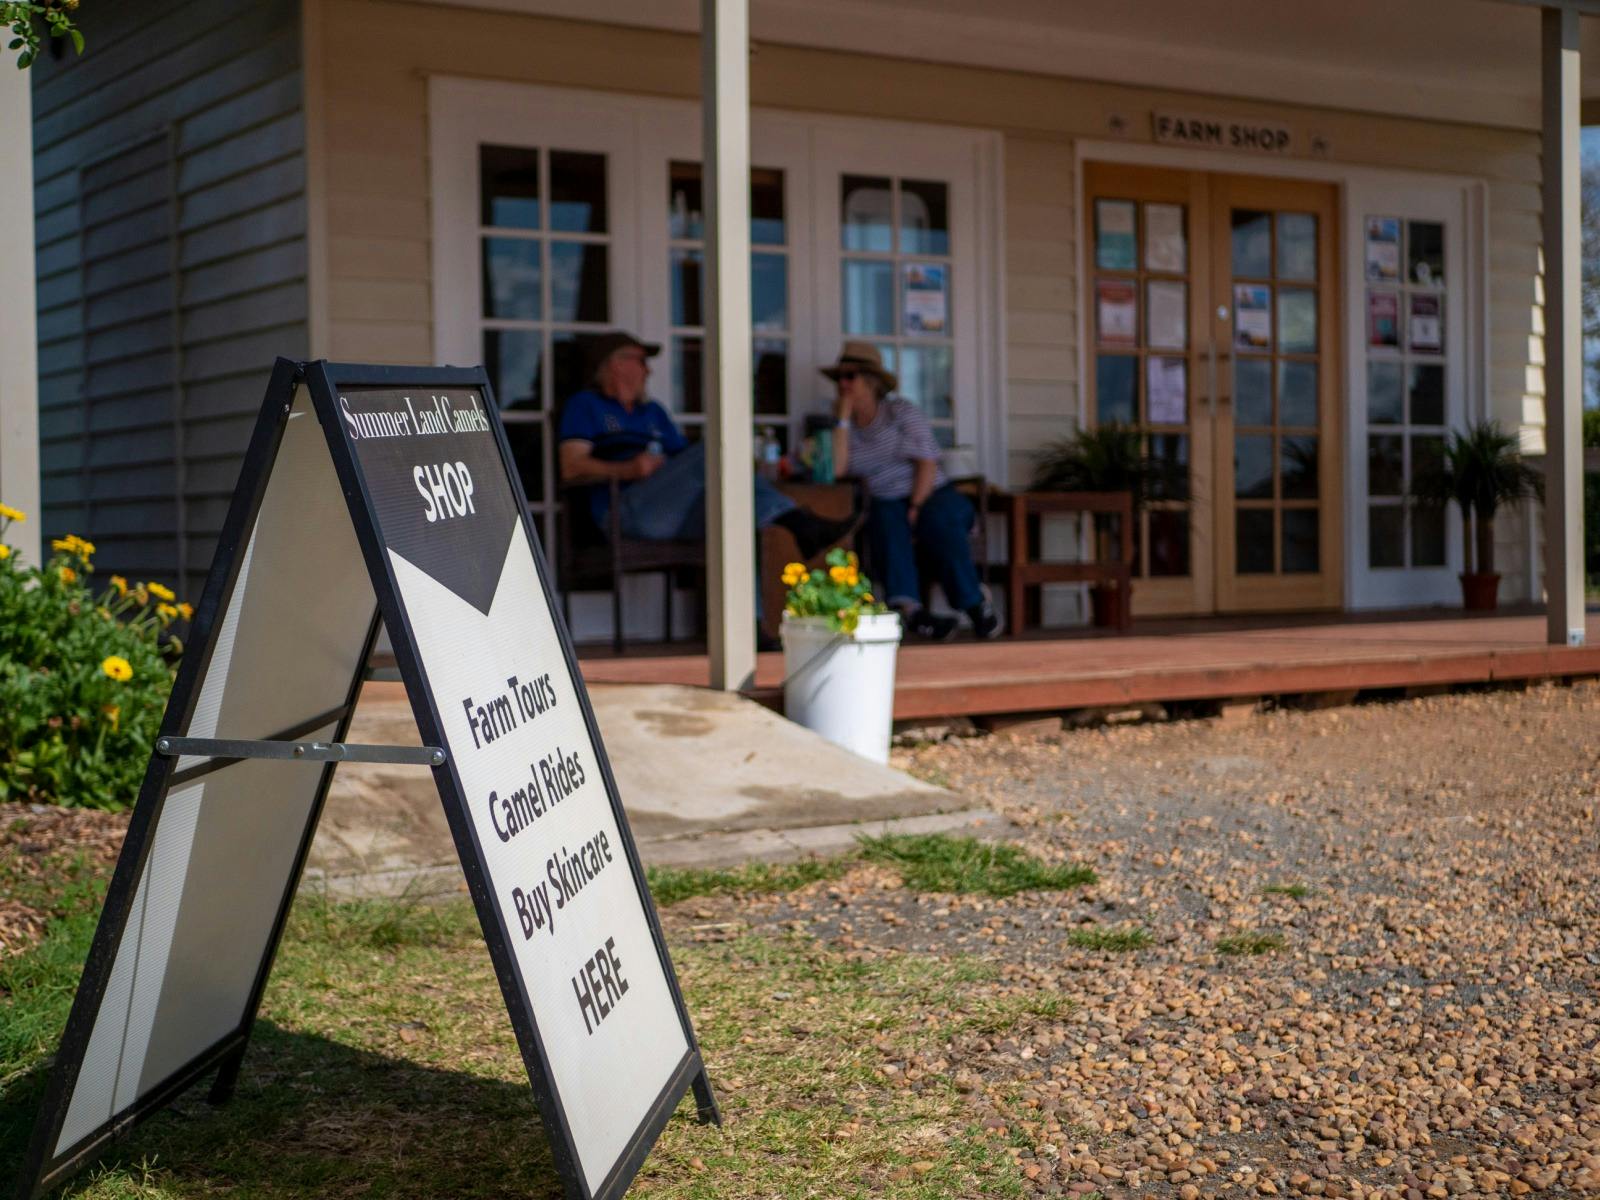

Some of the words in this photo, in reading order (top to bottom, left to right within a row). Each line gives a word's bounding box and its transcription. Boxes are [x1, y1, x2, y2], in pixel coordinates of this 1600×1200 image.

[1157, 117, 1222, 144] FARM
[1229, 124, 1290, 151] SHOP
[340, 397, 412, 439] Summer
[404, 396, 448, 435] Land
[441, 395, 490, 433] Camels
[413, 461, 476, 523] SHOP
[462, 697, 517, 749] Farm
[507, 673, 557, 723] Tours
[488, 764, 547, 843] Camel
[539, 747, 586, 807] Rides
[512, 881, 554, 941] Buy
[546, 830, 613, 909] Skincare
[571, 936, 630, 1036] HERE
